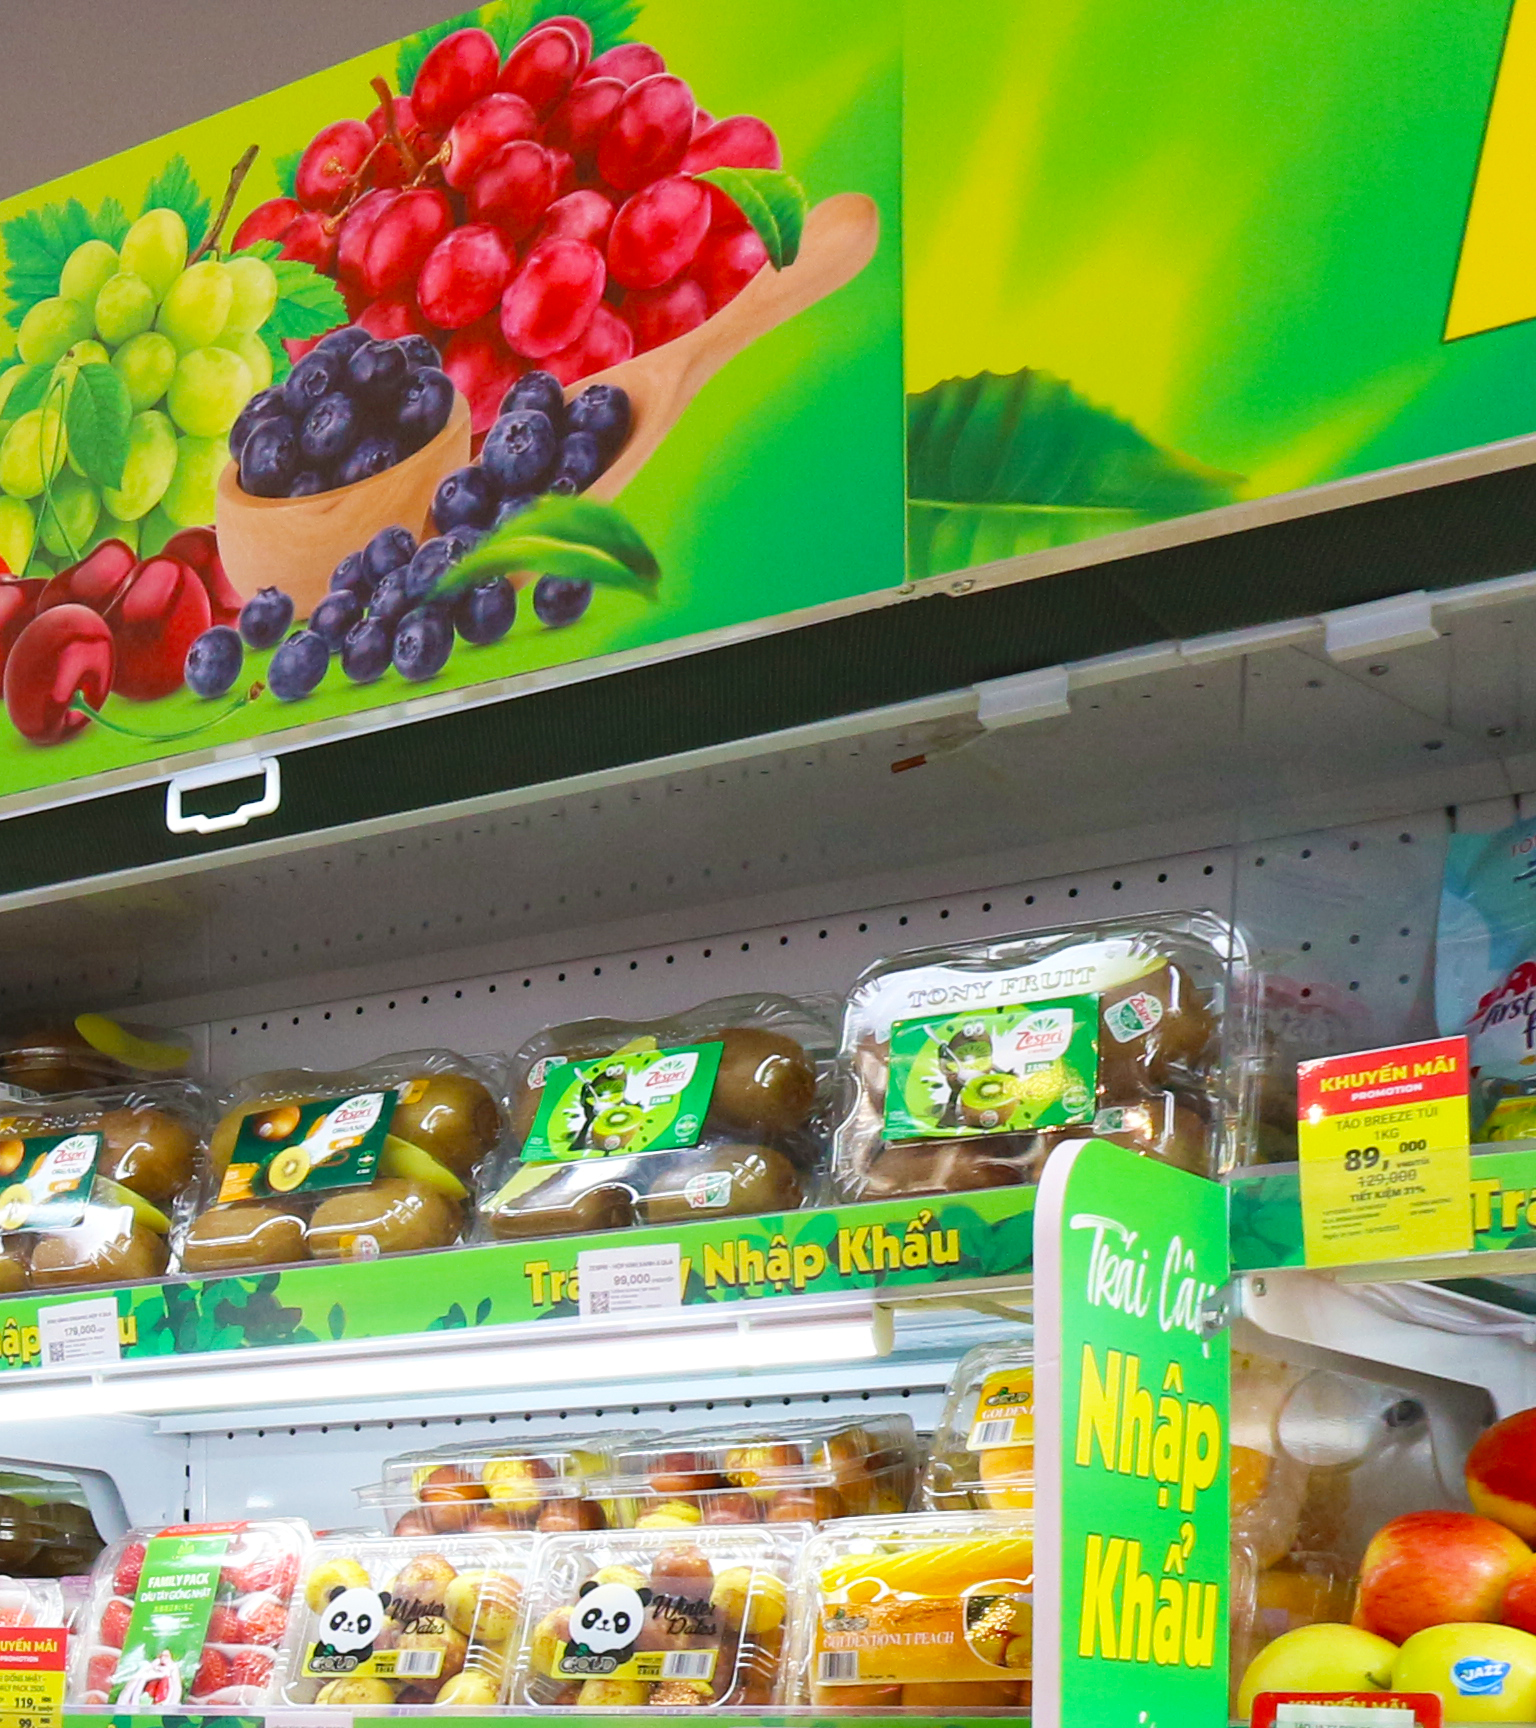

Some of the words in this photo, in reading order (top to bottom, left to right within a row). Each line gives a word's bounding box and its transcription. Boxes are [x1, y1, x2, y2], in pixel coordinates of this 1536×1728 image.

[908, 981, 994, 1008] TONY
[1001, 965, 1096, 995] FRUIT
[1014, 1029, 1064, 1051] Zespri
[644, 1067, 687, 1088] Zespri
[1320, 1061, 1409, 1094] KHUYẾN
[1413, 1055, 1457, 1076] MÃI
[1351, 1082, 1423, 1102] PROMOTION
[336, 1105, 374, 1125] Zespri
[1374, 1127, 1400, 1140] 1KG
[53, 1148, 88, 1166] Zespri
[1070, 1211, 1152, 1319] Trái
[1075, 1342, 1222, 1514] Nhập
[147, 1575, 182, 1589] FAMILY
[183, 1572, 209, 1585] PACK
[1077, 1521, 1219, 1669] Khẩu
[390, 1598, 447, 1621] Winter
[401, 1619, 446, 1637] Dates
[914, 1631, 955, 1645] PEACH
[36, 1638, 58, 1653] MÃI
[308, 1654, 360, 1673] GOLD
[557, 1655, 619, 1674] GOLD
[1465, 1664, 1503, 1680] JAZZ
